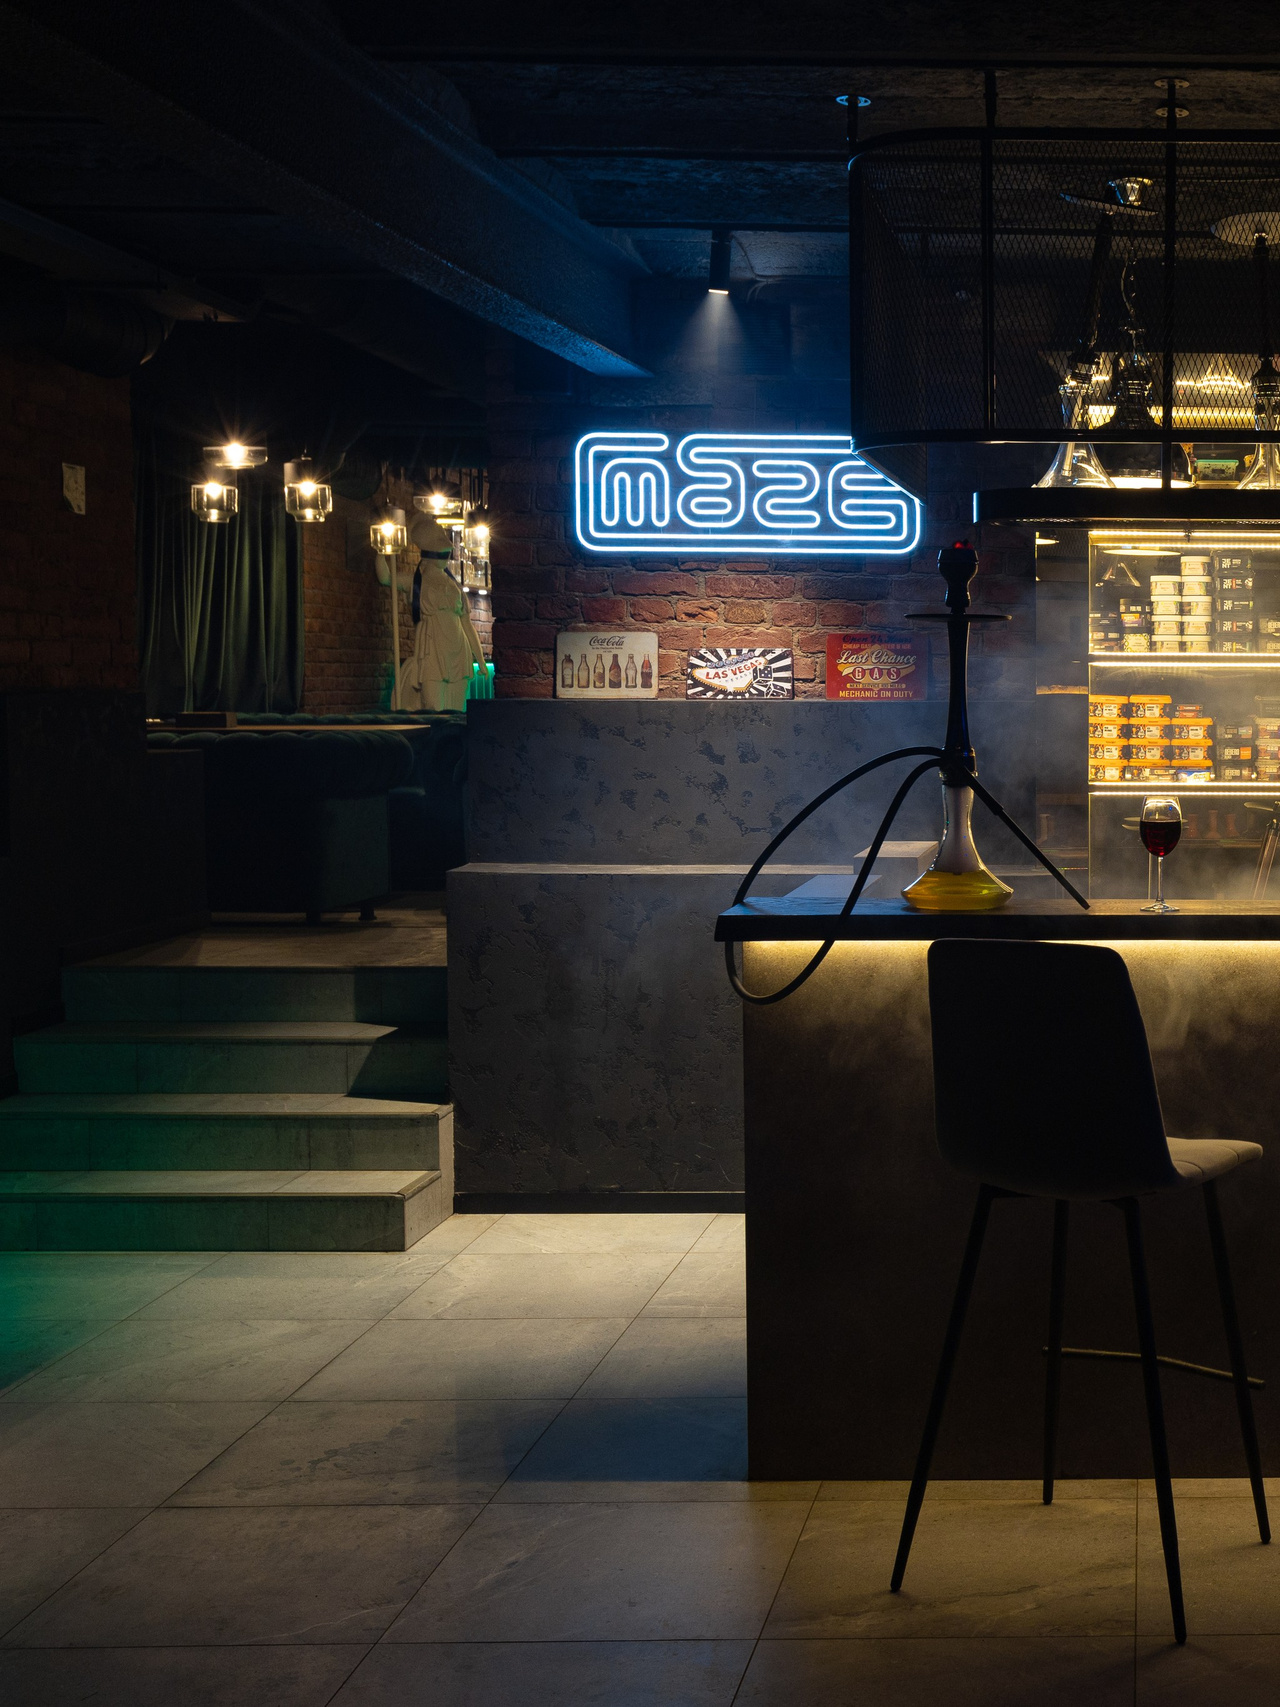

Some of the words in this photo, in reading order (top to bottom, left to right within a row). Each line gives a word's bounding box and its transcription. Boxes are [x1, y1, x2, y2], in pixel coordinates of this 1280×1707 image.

[837, 650, 868, 664] Last
[870, 650, 917, 664] Chance
[705, 670, 728, 680] LAS
[731, 660, 762, 676] VEGAS
[855, 668, 897, 679] GAS
[839, 690, 878, 698] MECHANIC
[881, 690, 891, 698] ON
[893, 690, 913, 698] DUTY
